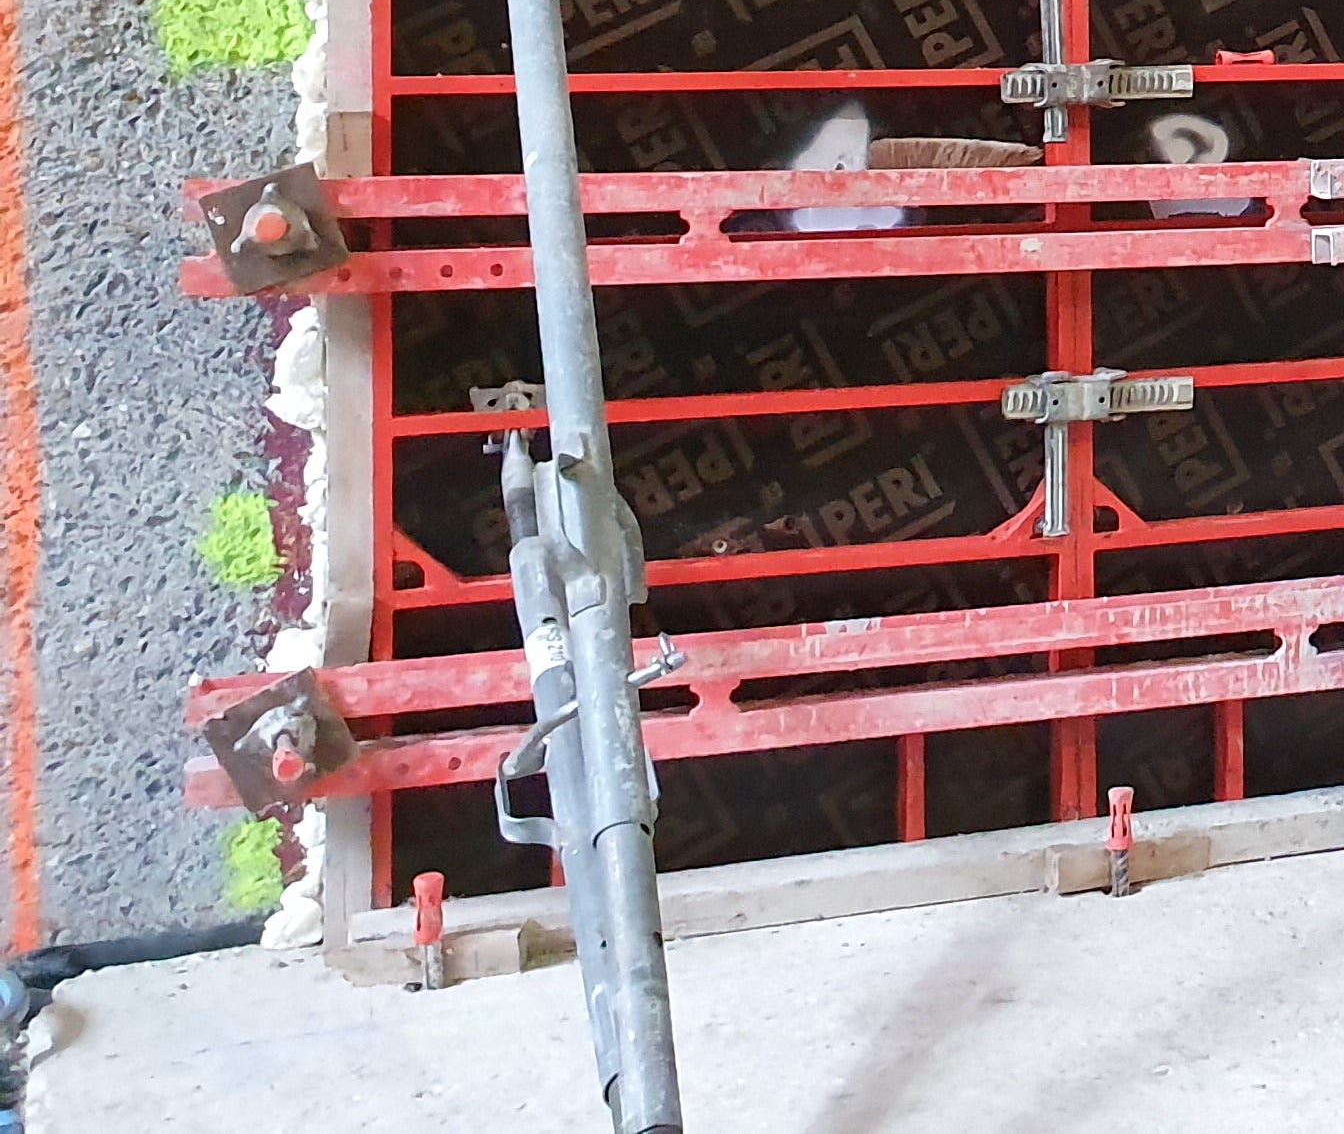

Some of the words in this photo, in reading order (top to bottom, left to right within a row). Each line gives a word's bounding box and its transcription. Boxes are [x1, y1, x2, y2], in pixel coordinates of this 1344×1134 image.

[881, 293, 1000, 382] PERI
[622, 431, 735, 518] PER
[818, 454, 943, 546] PERI
